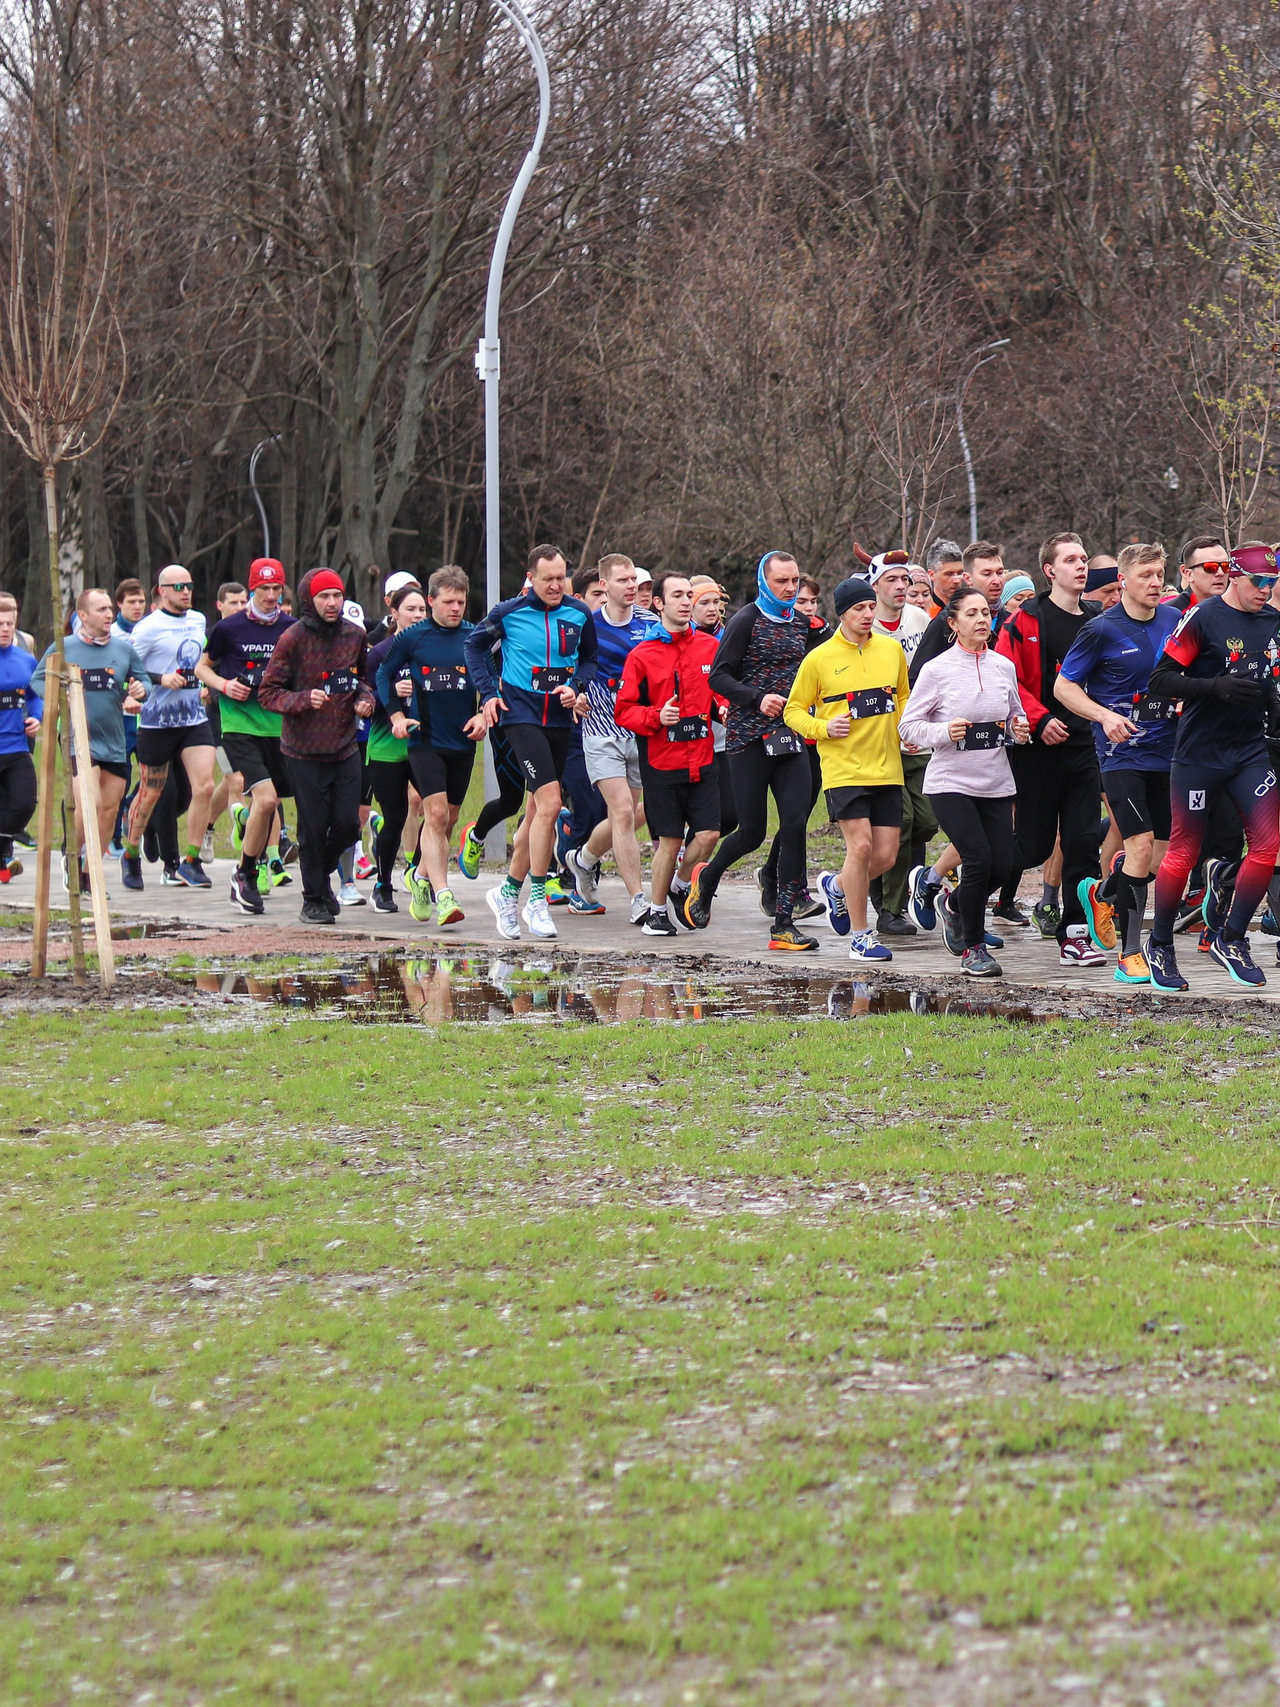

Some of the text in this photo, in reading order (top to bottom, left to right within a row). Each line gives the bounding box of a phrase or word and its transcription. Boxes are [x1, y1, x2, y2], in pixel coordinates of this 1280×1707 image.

[548, 674, 560, 682] 041
[865, 697, 878, 706] 107
[1148, 702, 1161, 710] 057
[683, 723, 695, 732] 036
[780, 735, 792, 743] 039
[975, 731, 990, 739] 082
